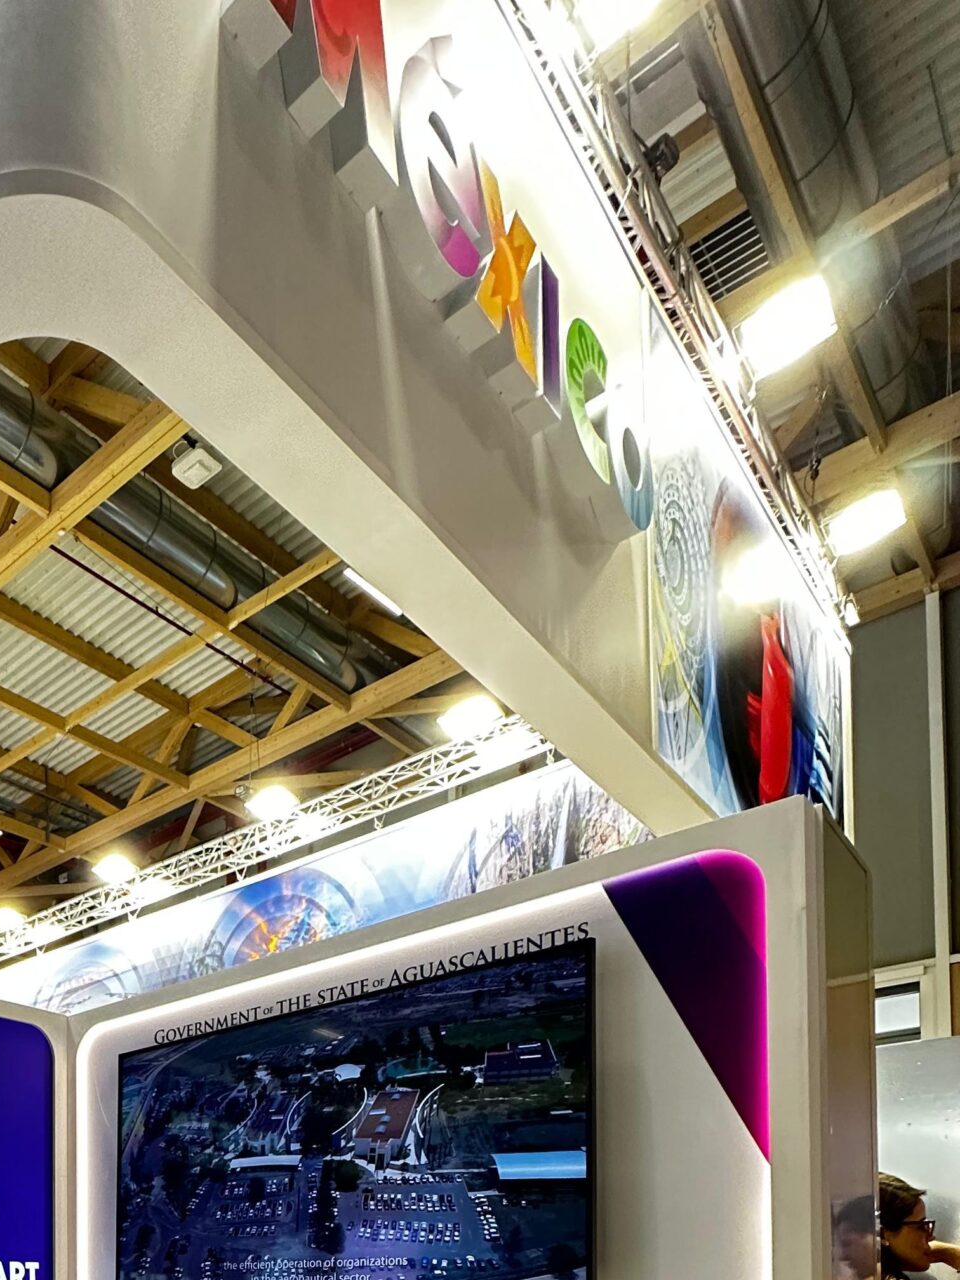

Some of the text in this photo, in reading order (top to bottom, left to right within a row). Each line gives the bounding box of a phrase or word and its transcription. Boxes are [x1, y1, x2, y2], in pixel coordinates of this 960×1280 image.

[154, 1006, 261, 1045] GOVERNMENT
[276, 993, 311, 1015] THE
[318, 978, 370, 1004] STATE
[390, 921, 590, 988] AGUASCALIENTES
[224, 1255, 408, 1273] the efficient operation of organizations
